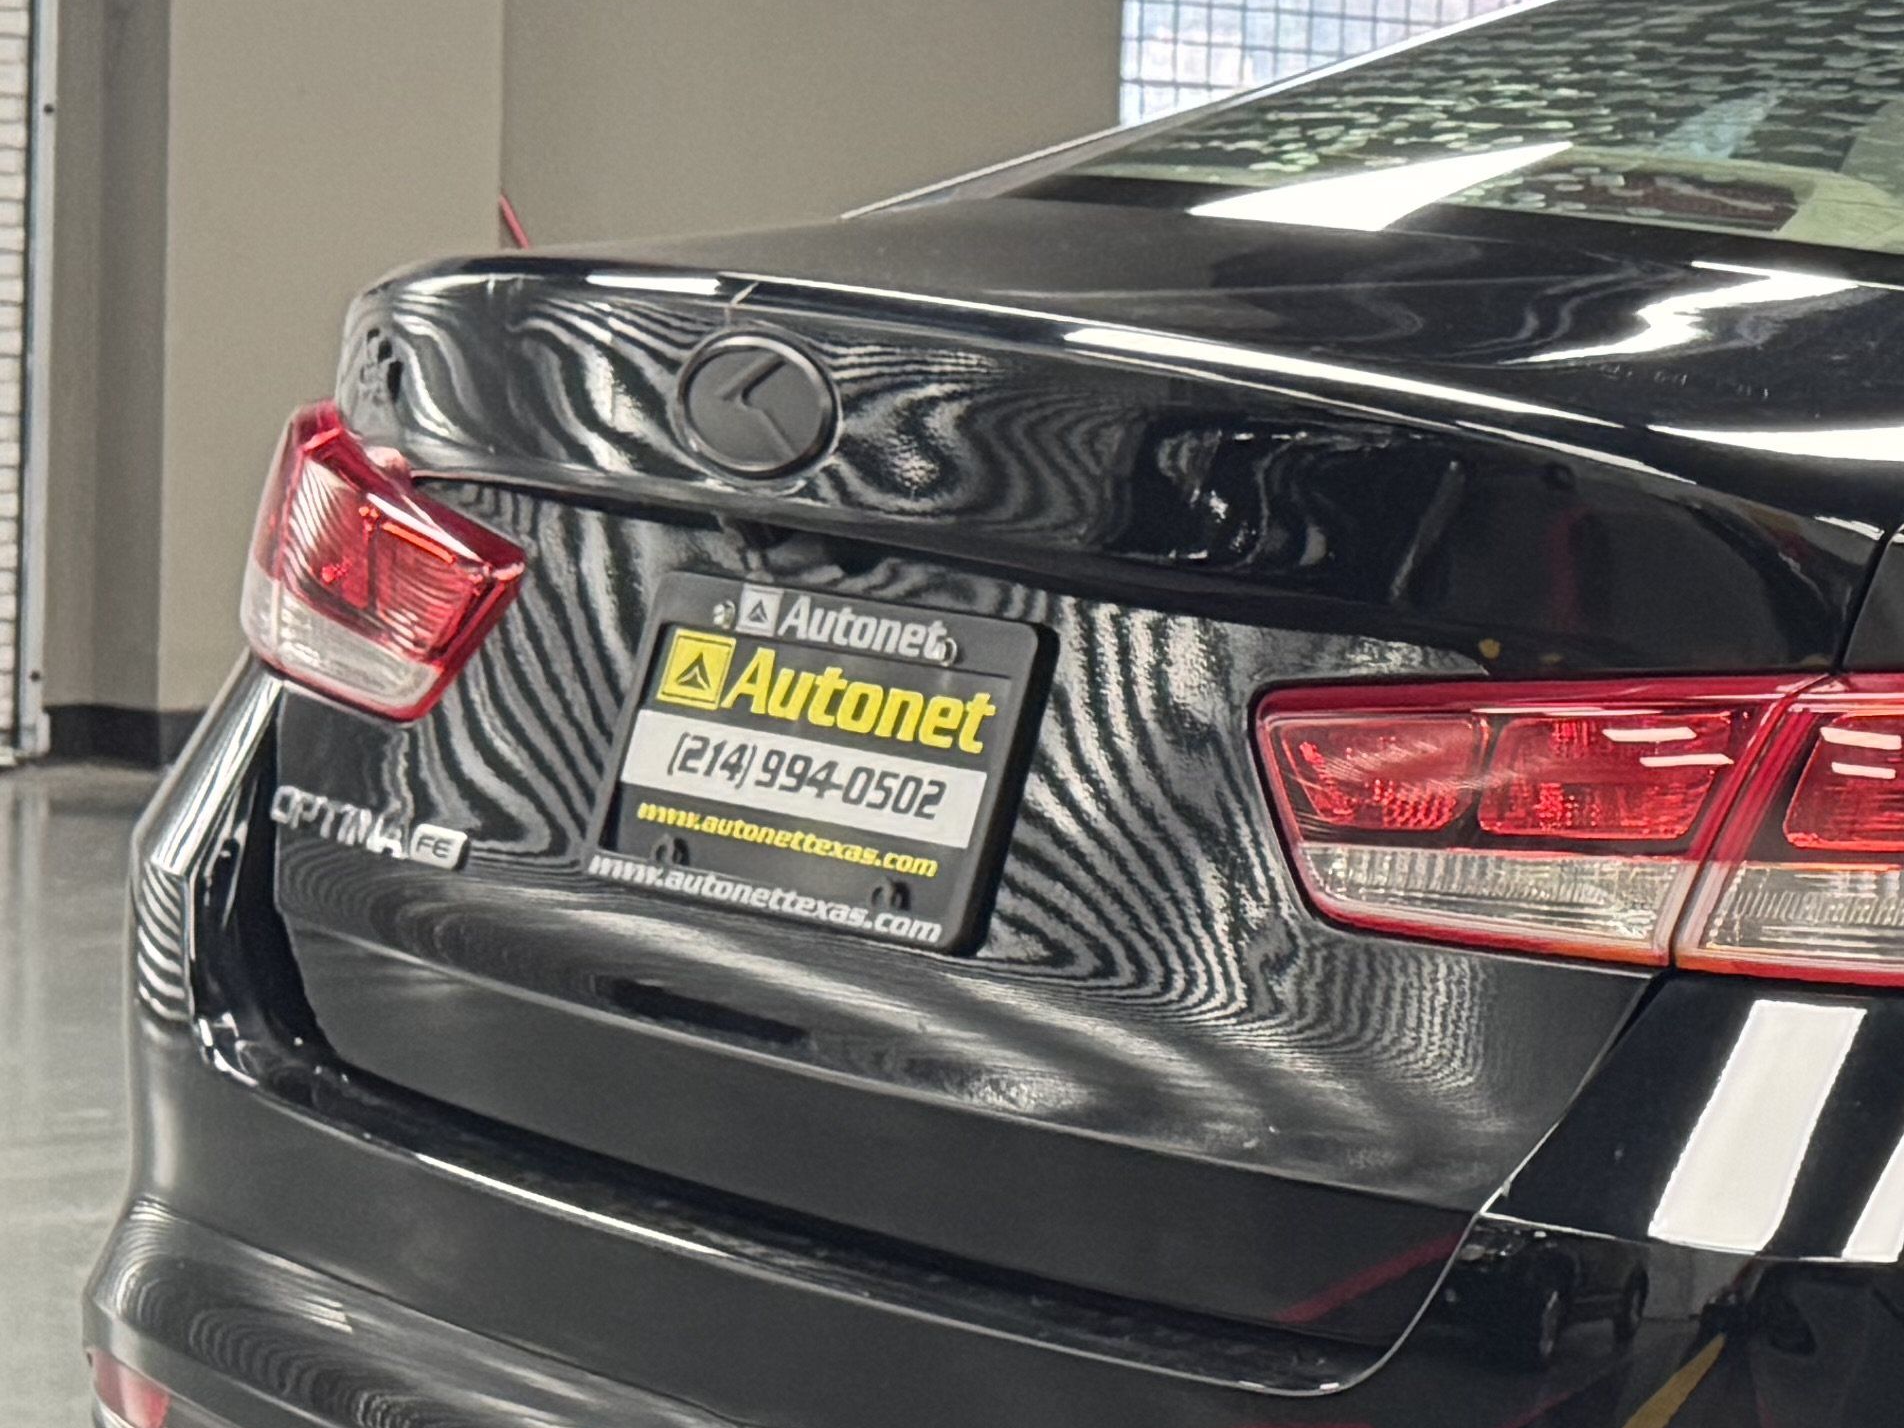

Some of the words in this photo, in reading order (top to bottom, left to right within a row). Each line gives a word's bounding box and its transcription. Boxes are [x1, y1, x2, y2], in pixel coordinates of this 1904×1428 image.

[776, 596, 948, 660] Autonet
[721, 647, 996, 754] Autonet
[667, 732, 758, 790] (214)
[754, 748, 947, 820] 994-0502
[417, 834, 451, 859] FE
[637, 802, 938, 878] www.autonettexas.com
[588, 854, 943, 944] www.autonettexas.com
